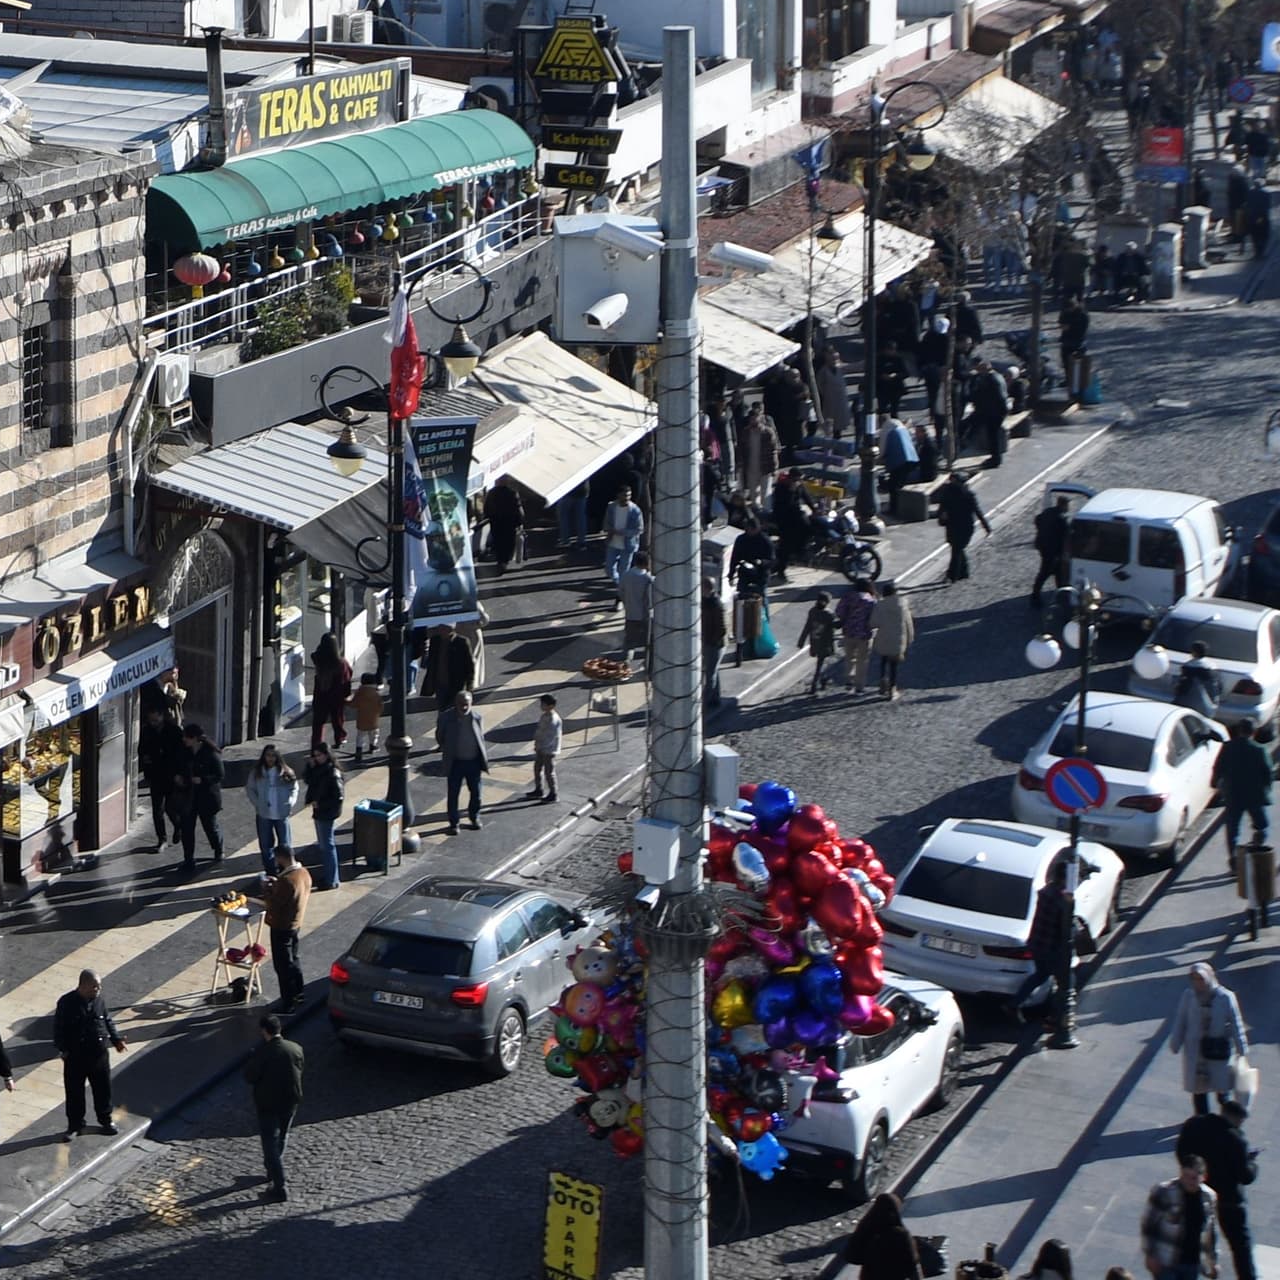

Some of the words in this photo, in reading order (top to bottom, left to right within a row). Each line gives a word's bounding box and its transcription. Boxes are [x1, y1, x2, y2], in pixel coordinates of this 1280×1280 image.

[330, 69, 392, 100] KAHVALTI
[550, 67, 601, 82] TERAS
[259, 81, 327, 139] TERAS
[329, 103, 339, 125] &
[344, 96, 379, 122] CAFE
[433, 166, 471, 185] TERAS
[557, 169, 595, 185] Cafe
[224, 217, 265, 240] TERAS
[51, 690, 86, 717] ÖZLEM
[90, 655, 160, 699] KUYUMCULUK
[554, 1190, 595, 1216] OTO
[564, 1215, 576, 1274] PARK
